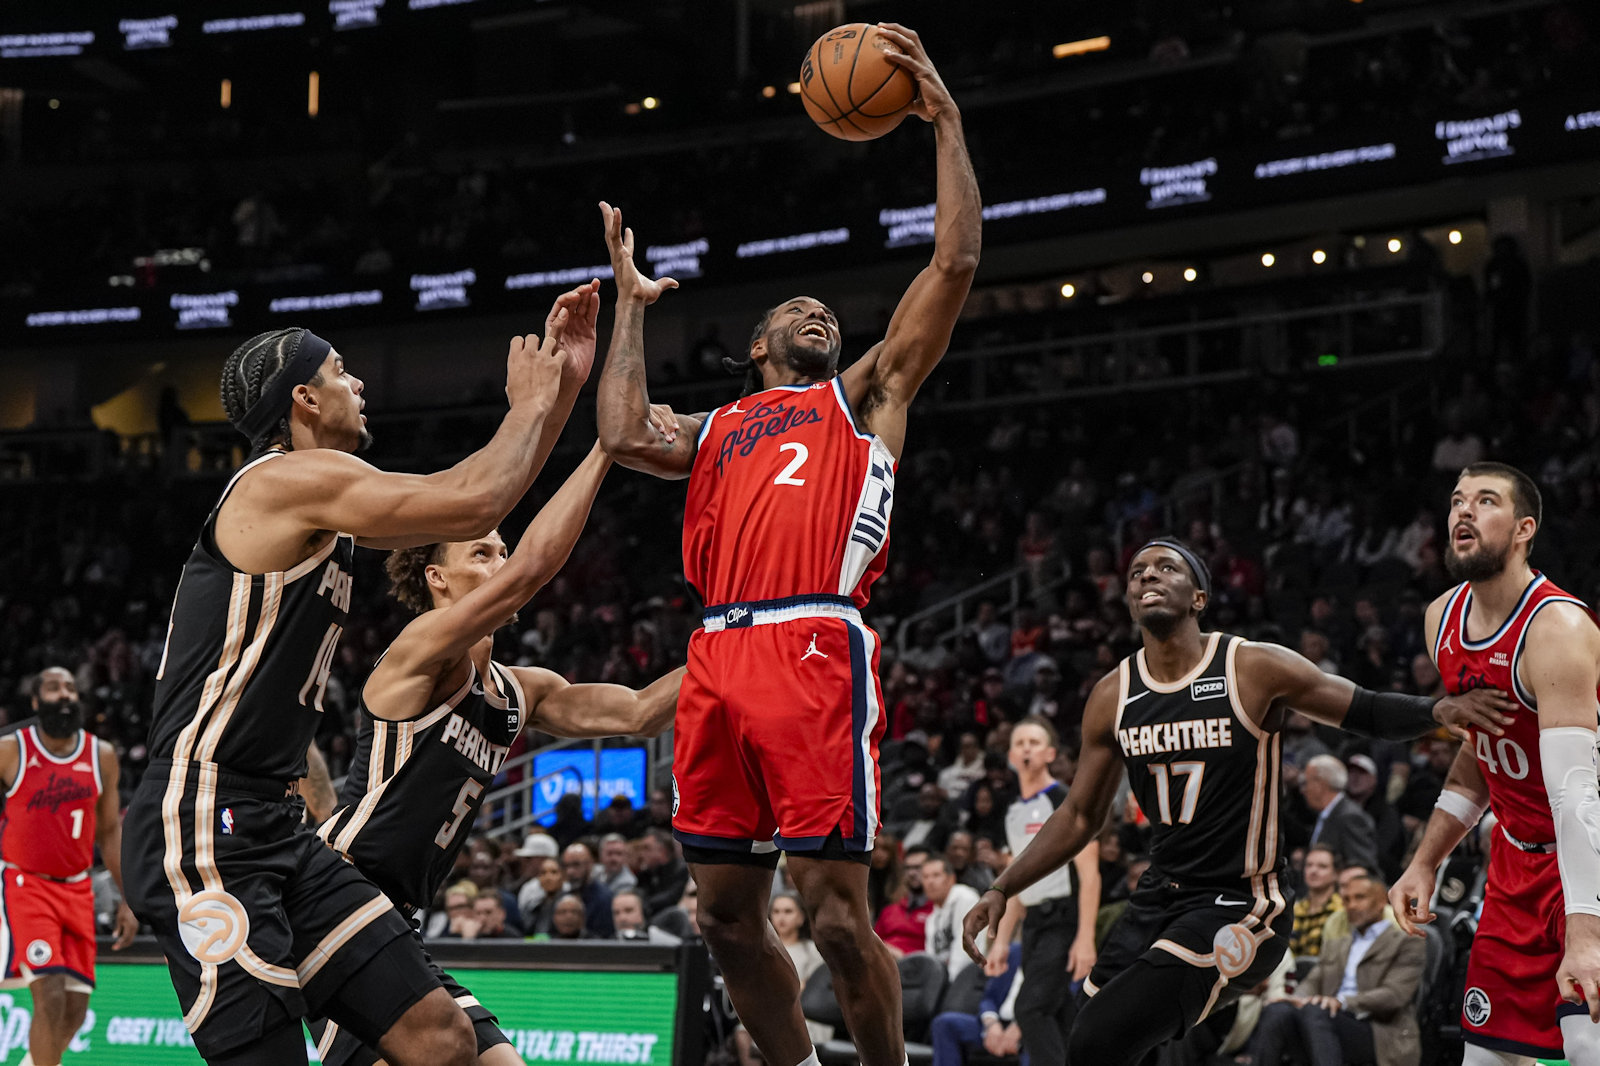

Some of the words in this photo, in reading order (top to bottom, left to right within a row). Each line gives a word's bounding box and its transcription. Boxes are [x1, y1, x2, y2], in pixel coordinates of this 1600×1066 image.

[741, 401, 788, 426] Los
[773, 441, 810, 487] 2
[726, 607, 749, 624] Clips
[1194, 682, 1224, 696] paze
[1118, 717, 1233, 758] PEACHTREE
[1475, 730, 1530, 781] 40
[1146, 760, 1206, 826] 17
[69, 808, 85, 840] 1
[434, 776, 484, 850] 5
[575, 1032, 659, 1064] THIRST
